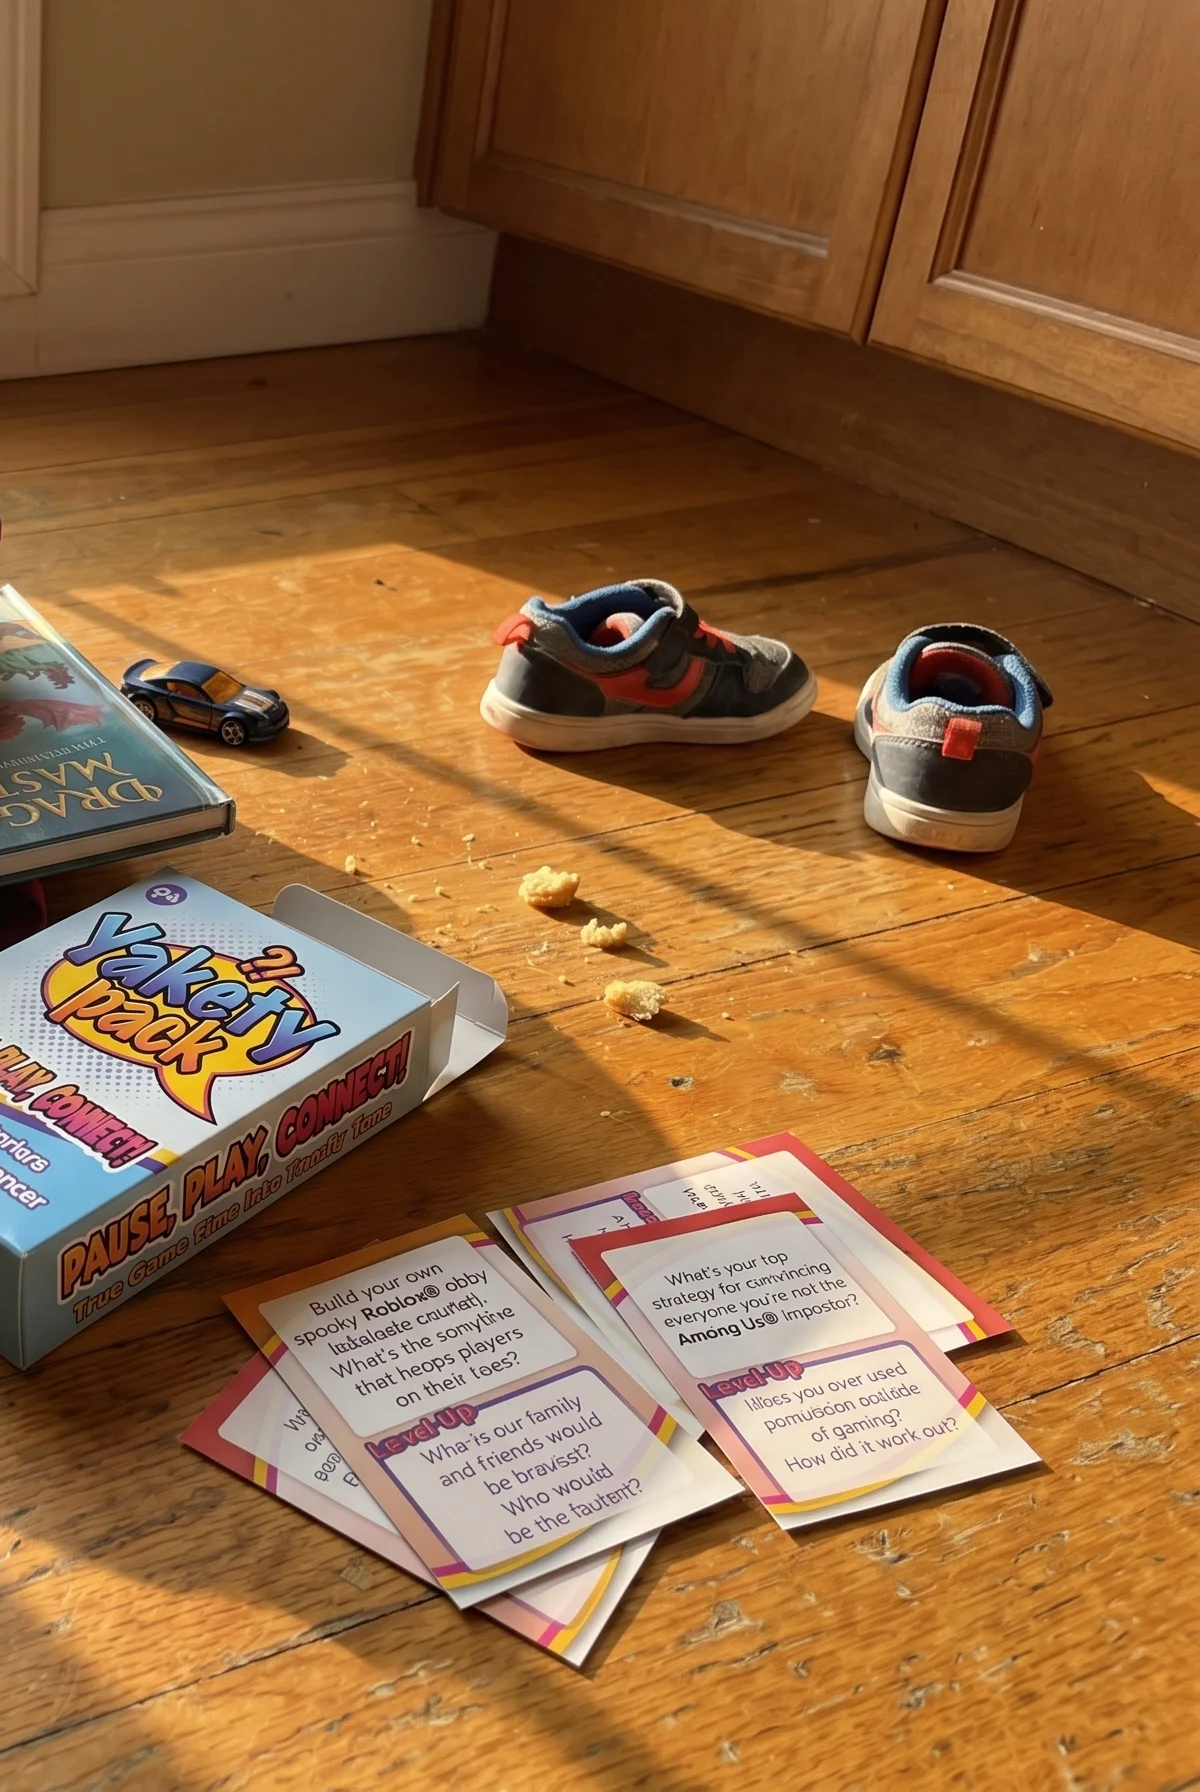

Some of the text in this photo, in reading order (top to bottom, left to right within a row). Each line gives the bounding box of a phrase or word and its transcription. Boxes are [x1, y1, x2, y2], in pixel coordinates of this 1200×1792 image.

[64, 911, 341, 1064] Yakety
[44, 978, 228, 1074] pack
[61, 1030, 412, 1301] PAUSE, PLAY, CONNECT!
[73, 1281, 124, 1325] True
[128, 1237, 189, 1288] Game
[361, 1277, 401, 1302] your
[405, 1263, 444, 1284] own
[664, 1252, 789, 1287] What's your top
[294, 1314, 358, 1347] spooky
[445, 1269, 488, 1293] obby
[652, 1286, 716, 1310] strategy
[718, 1280, 742, 1296] for
[664, 1277, 847, 1328] everyone you're not the
[678, 1322, 742, 1347] Among
[330, 1348, 400, 1380] What's
[401, 1336, 434, 1356] the
[355, 1373, 399, 1397] that
[458, 1328, 524, 1363] players
[395, 1390, 422, 1408] on
[469, 1351, 521, 1381] toes?
[792, 1384, 825, 1404] you
[828, 1373, 865, 1393] over
[868, 1362, 908, 1383] used
[493, 1418, 523, 1438] our
[526, 1395, 582, 1426] family
[811, 1408, 903, 1443] of gaming?
[439, 1412, 603, 1488] and friends would
[784, 1417, 959, 1473] How did it work out?
[484, 1473, 513, 1496] be
[500, 1490, 550, 1517] Who
[504, 1522, 534, 1545] be
[534, 1504, 570, 1532] the
